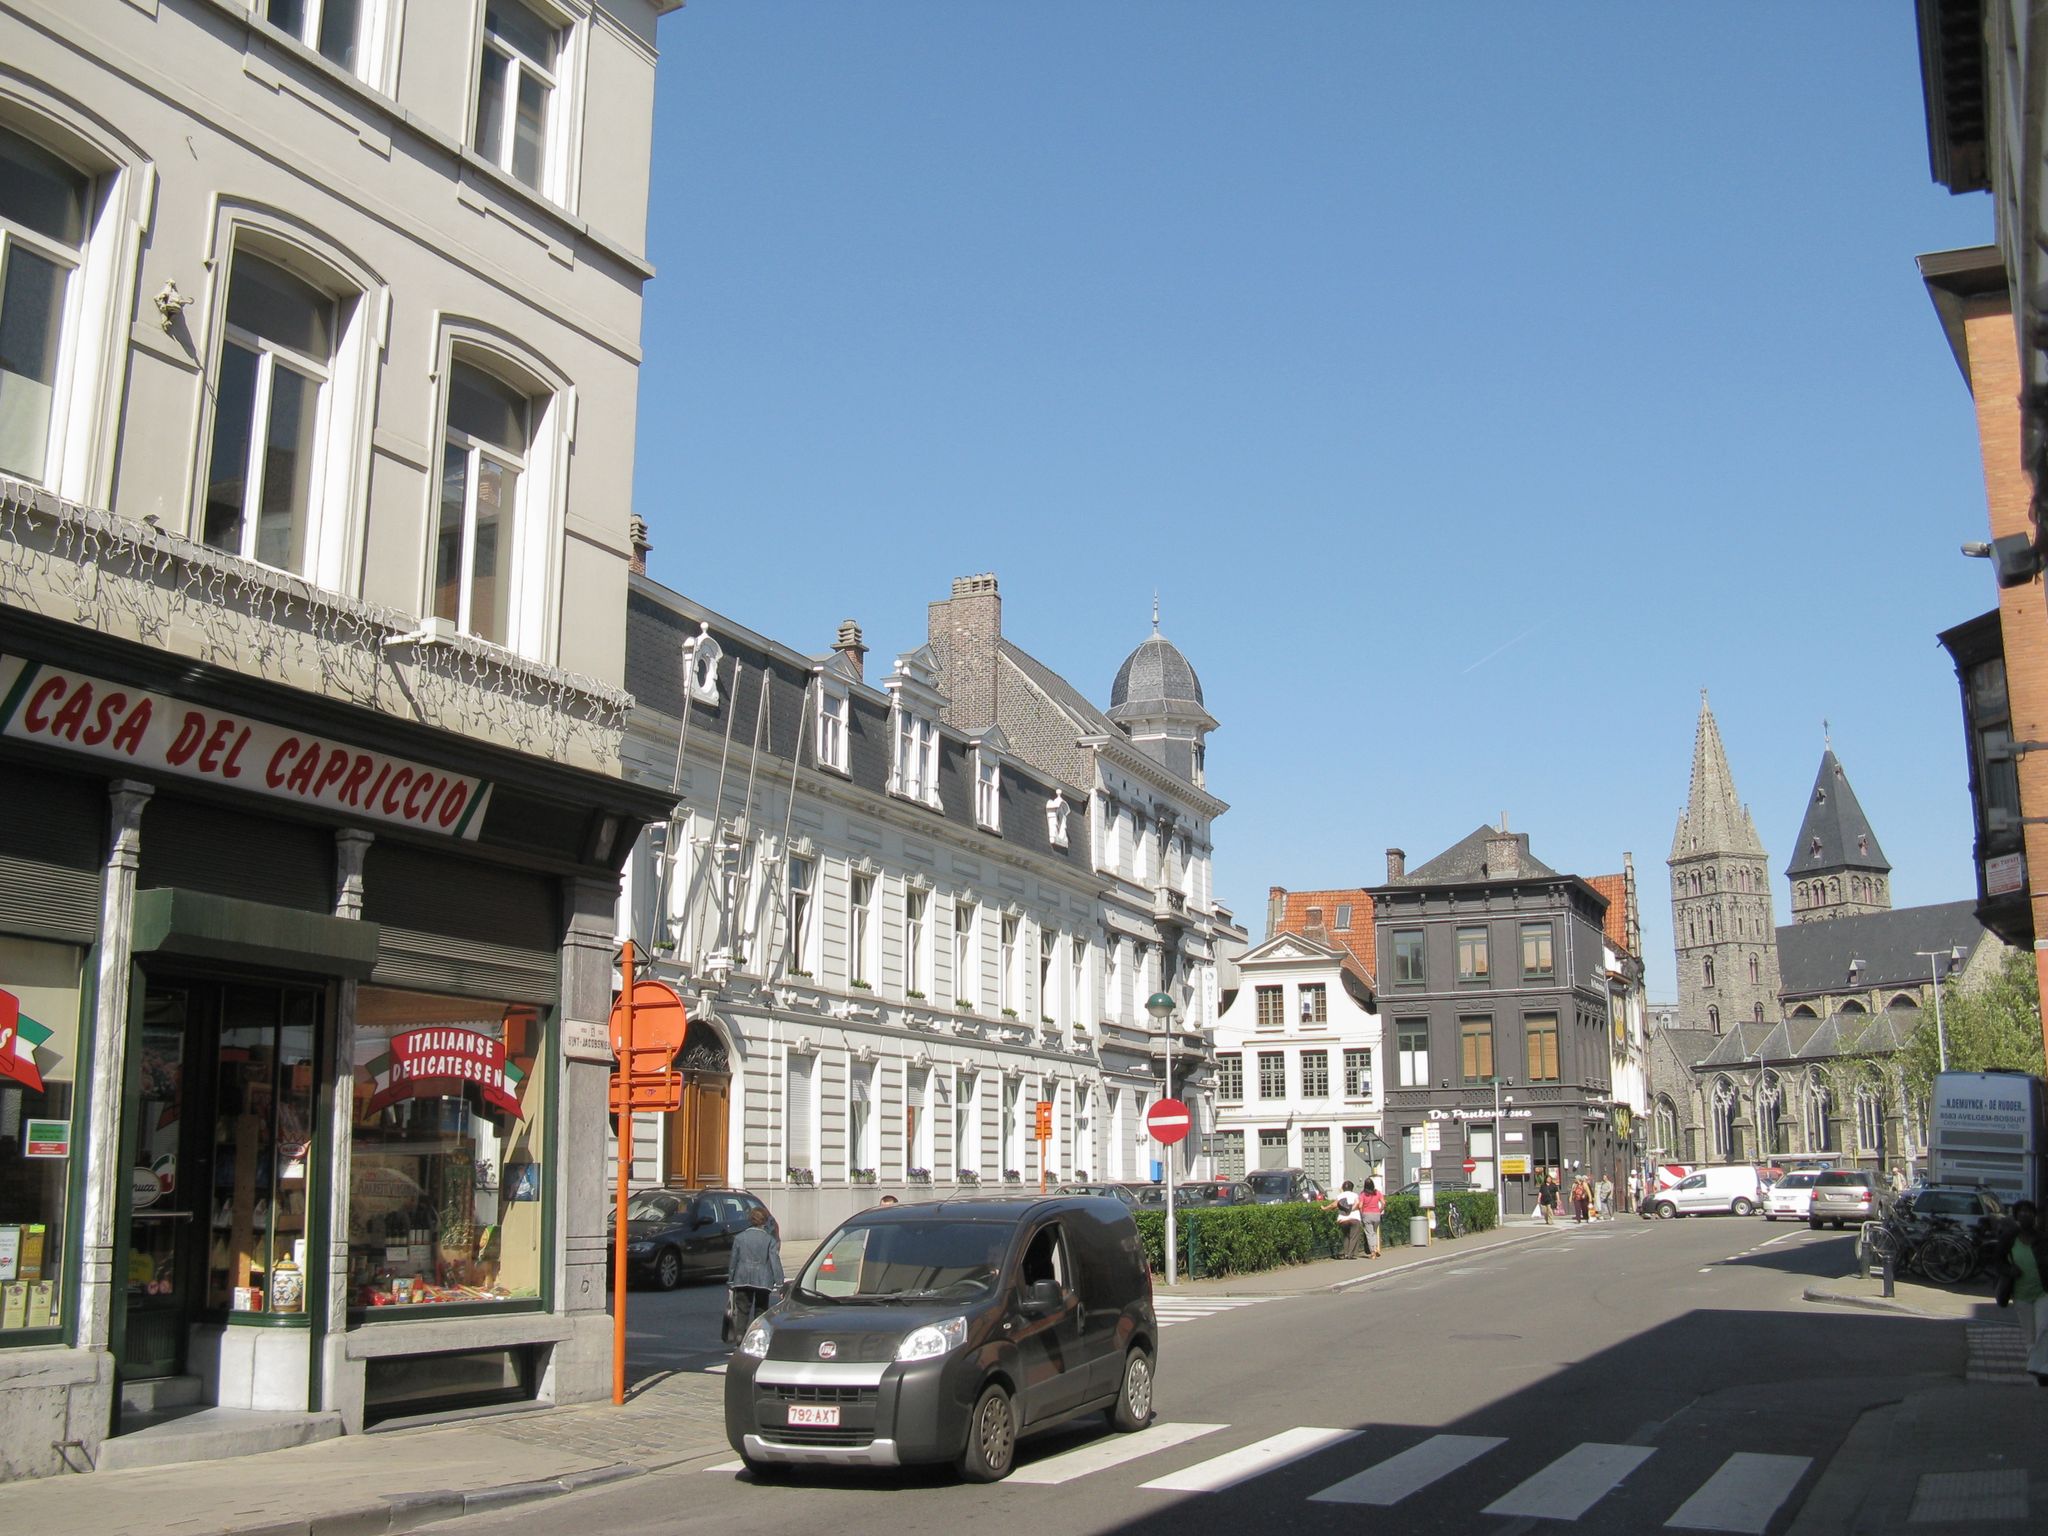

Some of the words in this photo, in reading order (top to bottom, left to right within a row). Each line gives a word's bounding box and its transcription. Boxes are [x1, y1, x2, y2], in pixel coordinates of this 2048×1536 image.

[24, 674, 153, 756] CASA
[165, 710, 252, 779] DEL
[265, 736, 469, 828] CAPRICCIO
[407, 1030, 494, 1058] ITALIAANSE
[392, 1055, 503, 1088] DELICATESSEN
[1427, 1109, 1449, 1120] De
